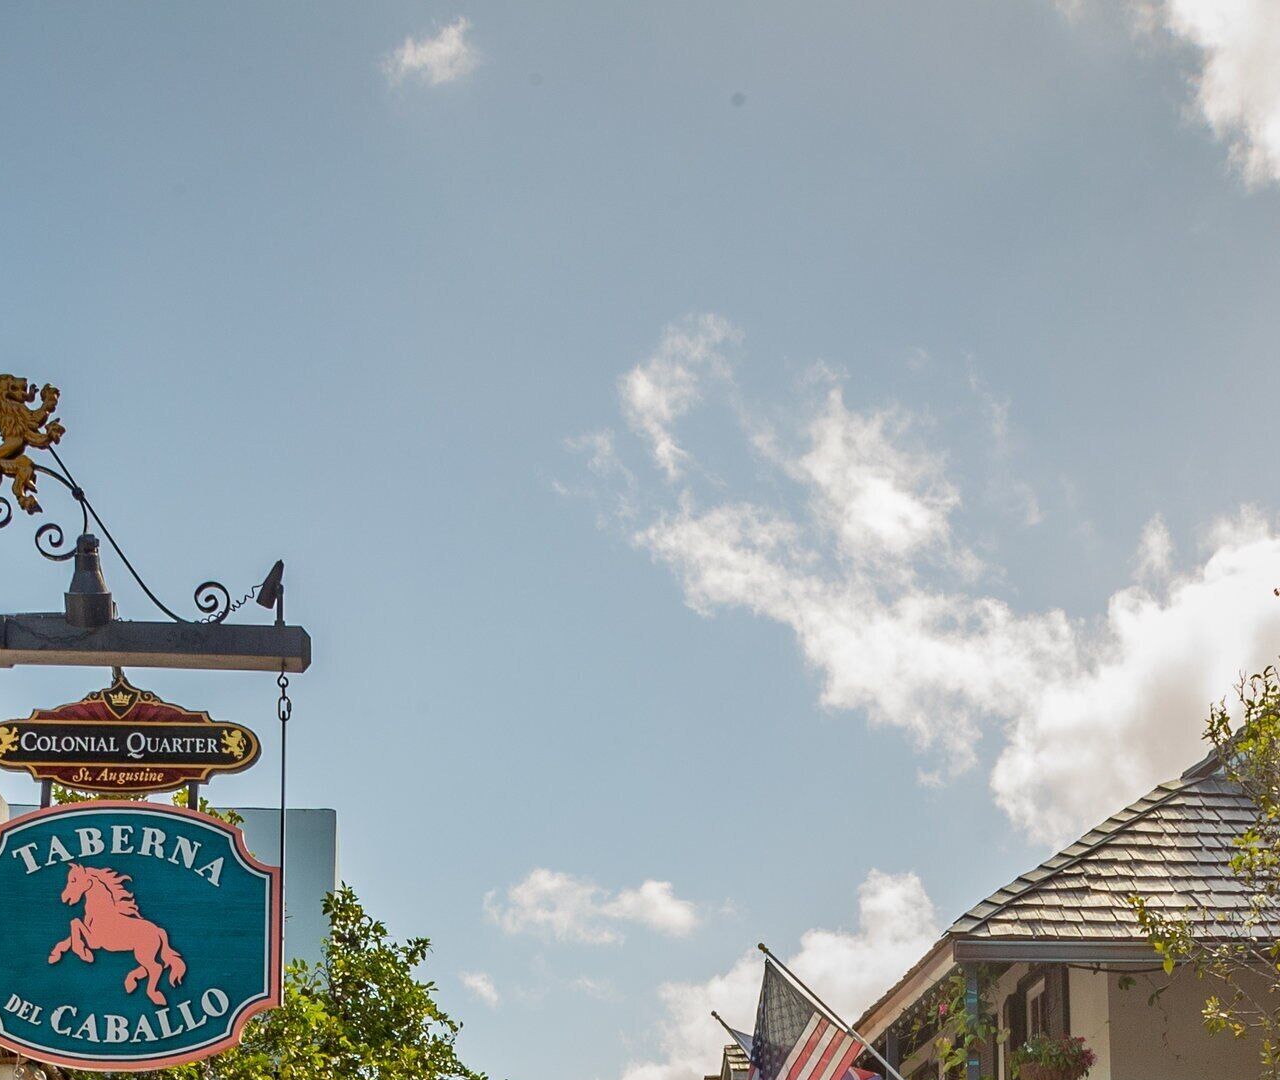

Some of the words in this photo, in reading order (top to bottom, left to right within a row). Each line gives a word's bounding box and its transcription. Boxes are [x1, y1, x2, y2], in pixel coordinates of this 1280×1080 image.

[73, 767, 92, 783] St.
[96, 768, 165, 785] Augustine
[12, 825, 226, 887] TABERNA
[3, 993, 43, 1026] DEL
[50, 987, 230, 1044] CABALLO
